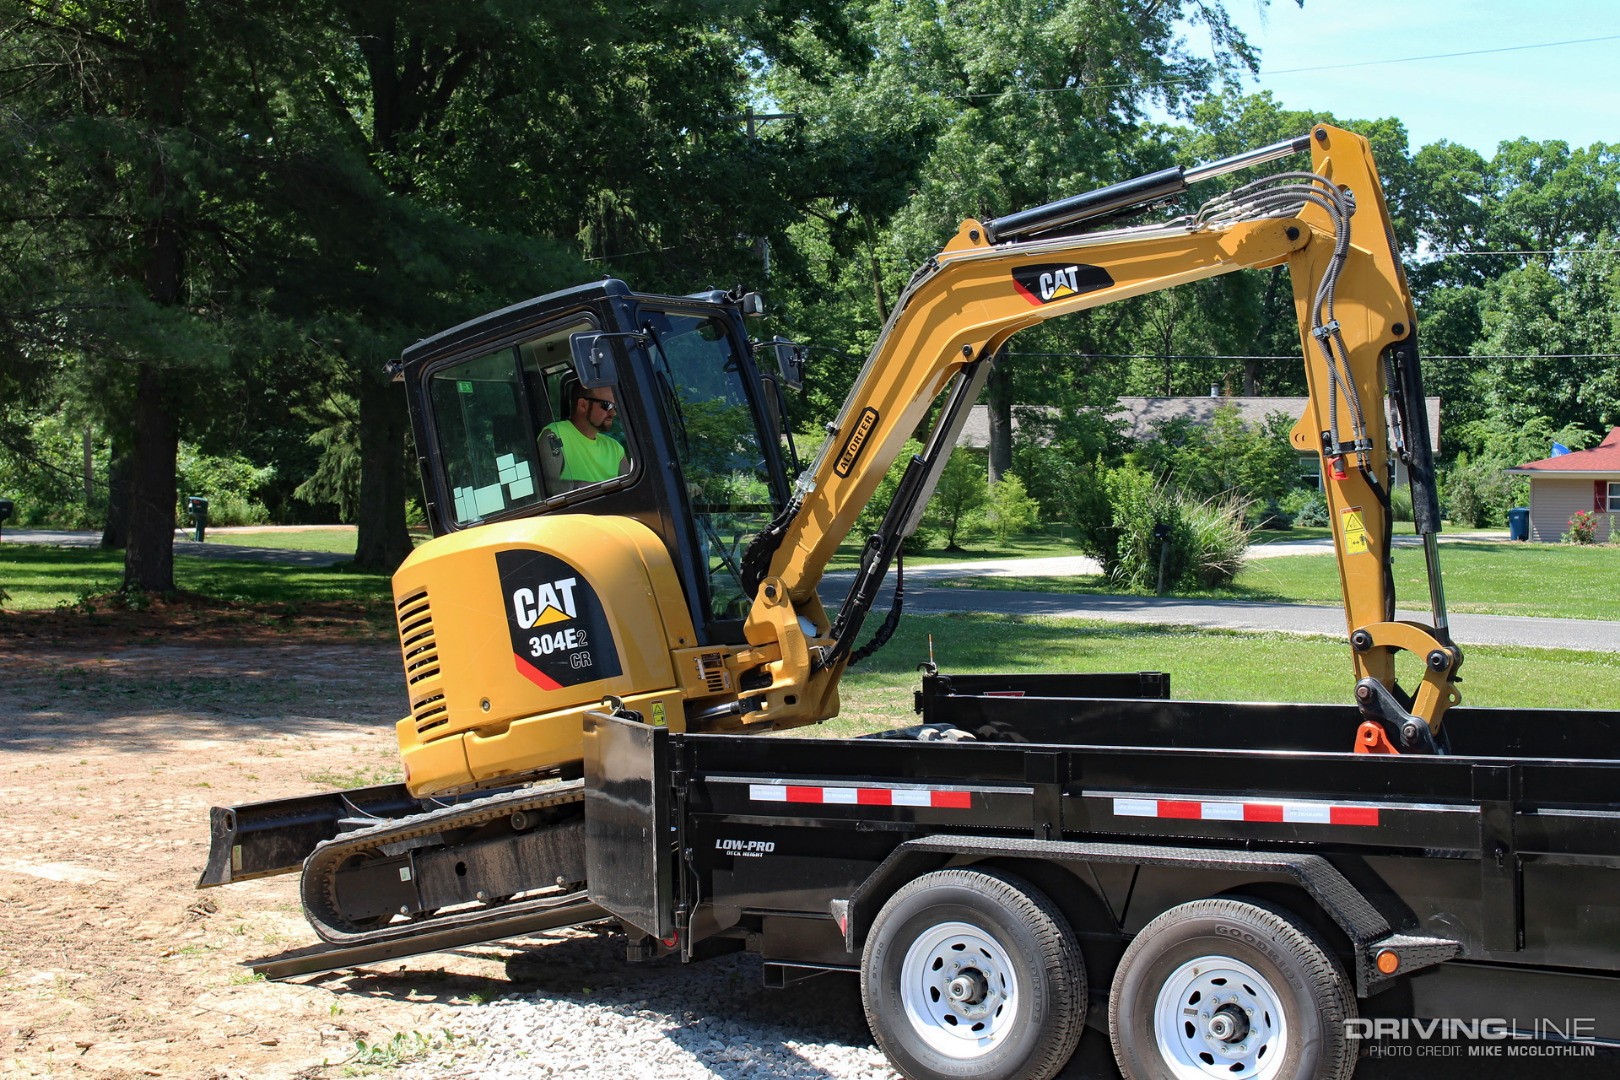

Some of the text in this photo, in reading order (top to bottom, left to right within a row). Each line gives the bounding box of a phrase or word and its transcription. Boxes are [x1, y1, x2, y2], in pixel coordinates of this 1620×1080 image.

[1040, 266, 1078, 300] CAT
[840, 415, 873, 470] ALTORFER
[513, 577, 577, 629] CAT
[529, 628, 588, 658] 304E2
[569, 651, 592, 669] CR
[715, 839, 775, 852] LOW-PRO
[1216, 926, 1303, 992] GOODRIDE
